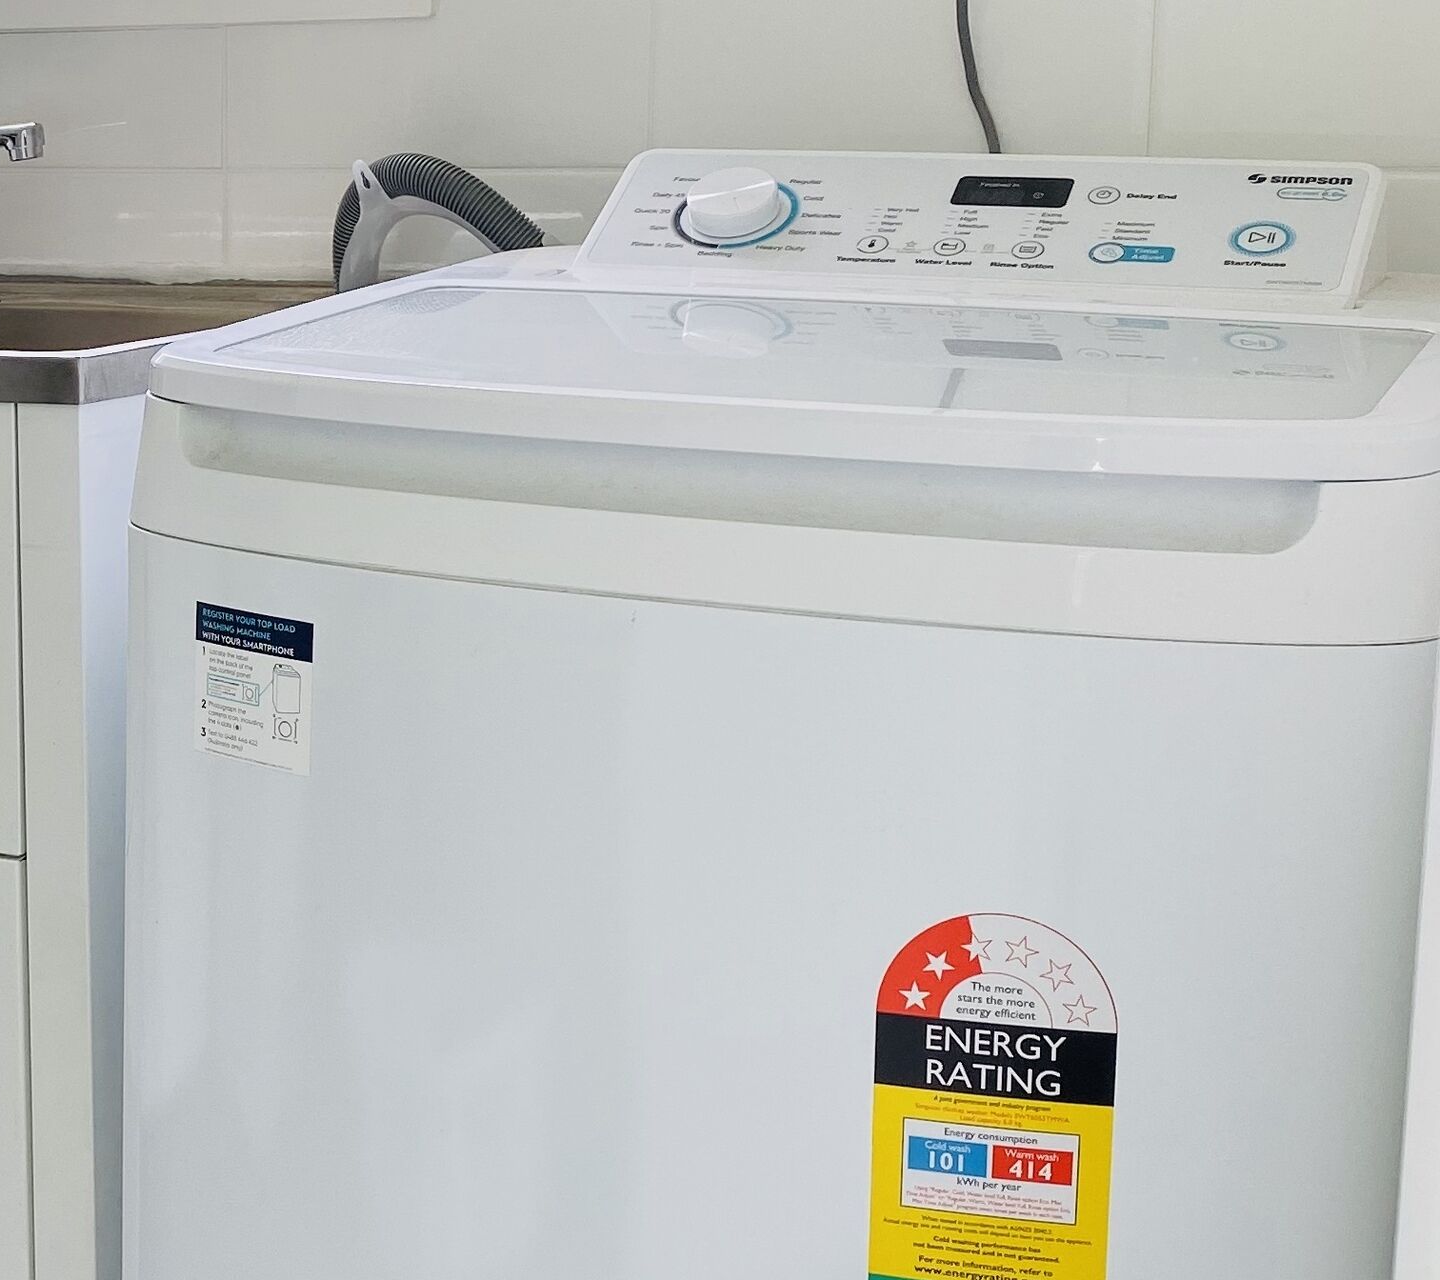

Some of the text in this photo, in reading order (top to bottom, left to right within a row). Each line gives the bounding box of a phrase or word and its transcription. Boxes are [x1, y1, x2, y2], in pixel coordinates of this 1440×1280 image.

[1270, 176, 1353, 185] SIMPSON
[202, 608, 296, 633] REGISTER YOUR TOP LOAD
[202, 620, 271, 640] WASHING MACHINE
[202, 630, 295, 657] WITH YOUR SMARTPHONE
[202, 646, 206, 656] 1
[201, 699, 207, 709] 2
[201, 727, 206, 737] 3
[971, 981, 1023, 995] The more
[957, 994, 1035, 1009] stars the more
[956, 1006, 1036, 1021] energy efficient
[925, 1024, 1067, 1062] ENERGY
[925, 1058, 1061, 1097] RATING
[944, 1128, 1038, 1144] Energy consumption
[925, 1141, 971, 1153] Cold wash
[929, 1152, 964, 1172] 101
[1004, 1149, 1059, 1162] Warm wash
[1009, 1160, 1052, 1181] 414
[957, 1177, 1021, 1192] kWh per year
[919, 1255, 932, 1263] For
[936, 1258, 960, 1267] more
[962, 1260, 1016, 1274] information,
[1019, 1268, 1041, 1276] refer
